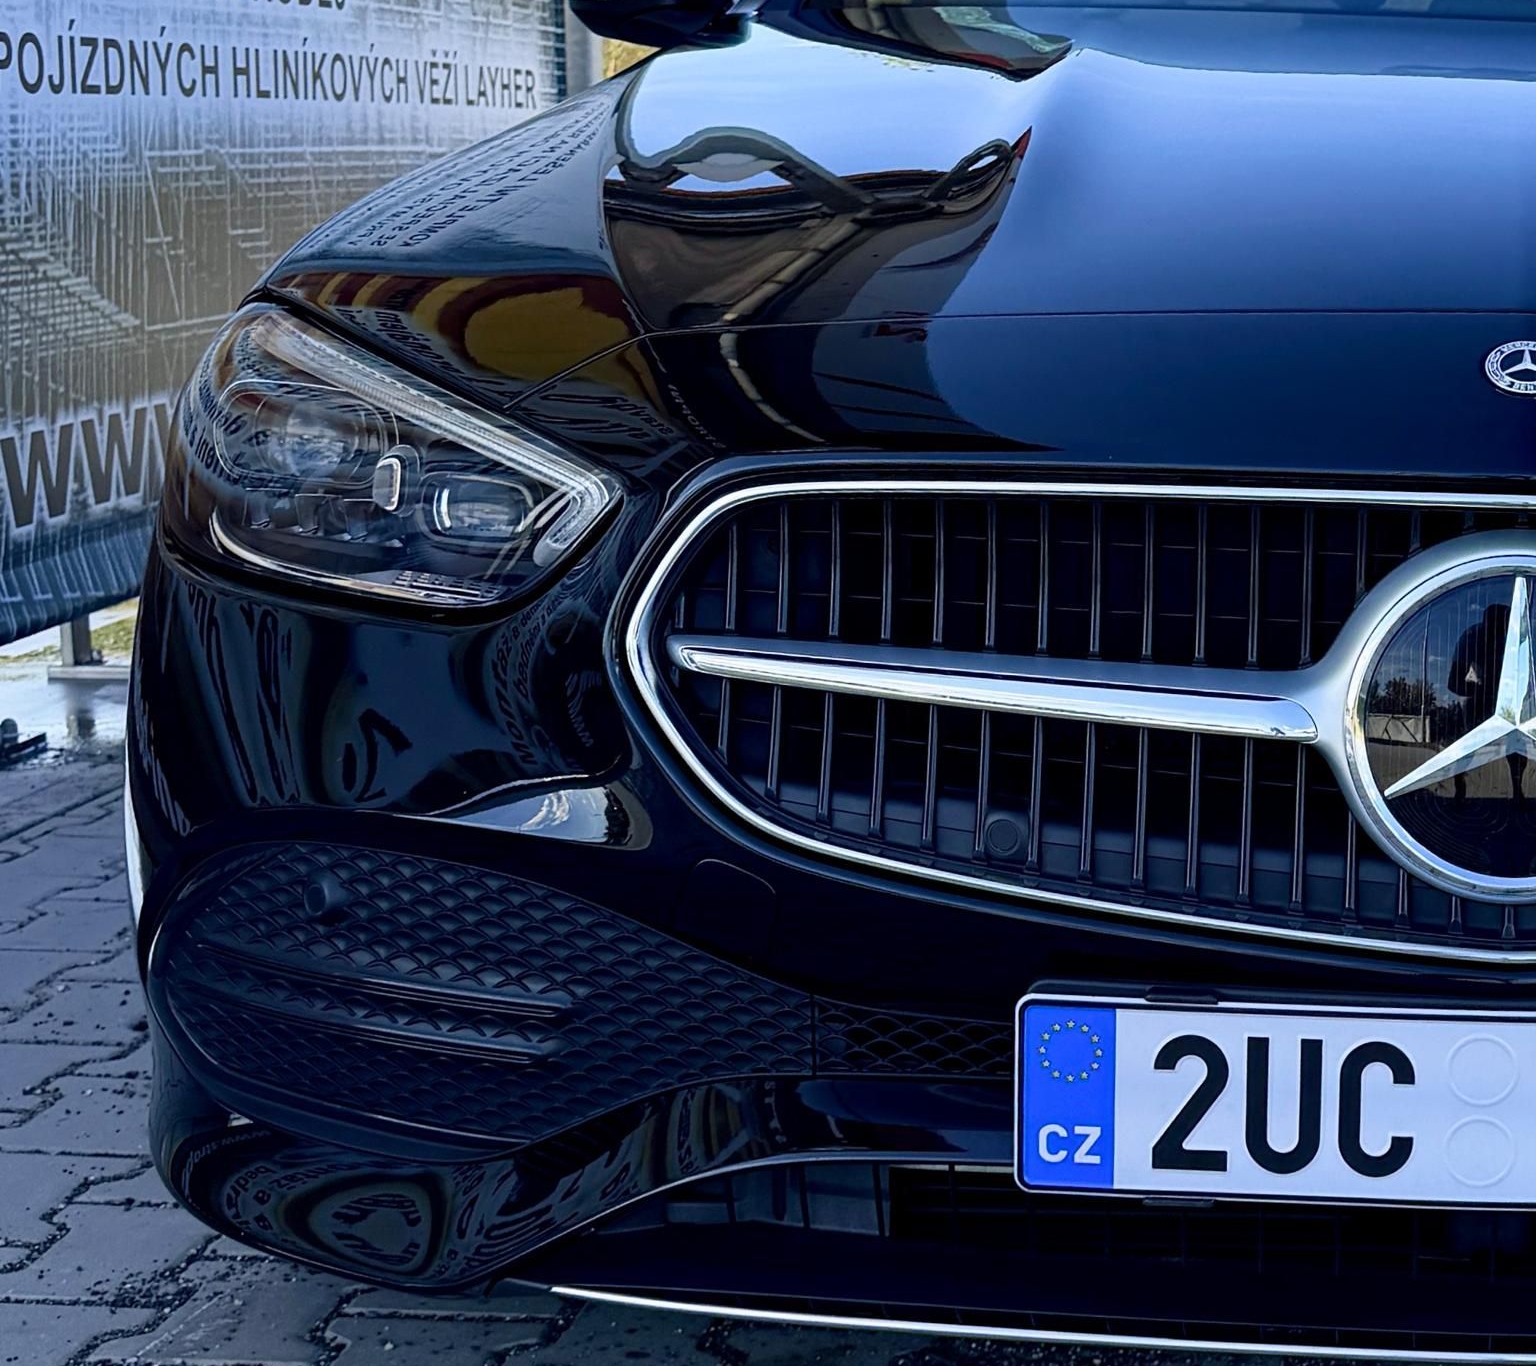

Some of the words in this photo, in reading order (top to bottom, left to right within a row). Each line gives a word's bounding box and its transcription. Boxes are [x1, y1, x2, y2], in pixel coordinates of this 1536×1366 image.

[232, 37, 409, 105] HLINÍKOVÝCH
[416, 47, 459, 107] VĚŽÍ
[465, 64, 538, 110] LAYHER
[1150, 1033, 1417, 1178] 2UC
[1036, 1123, 1103, 1166] CZ
